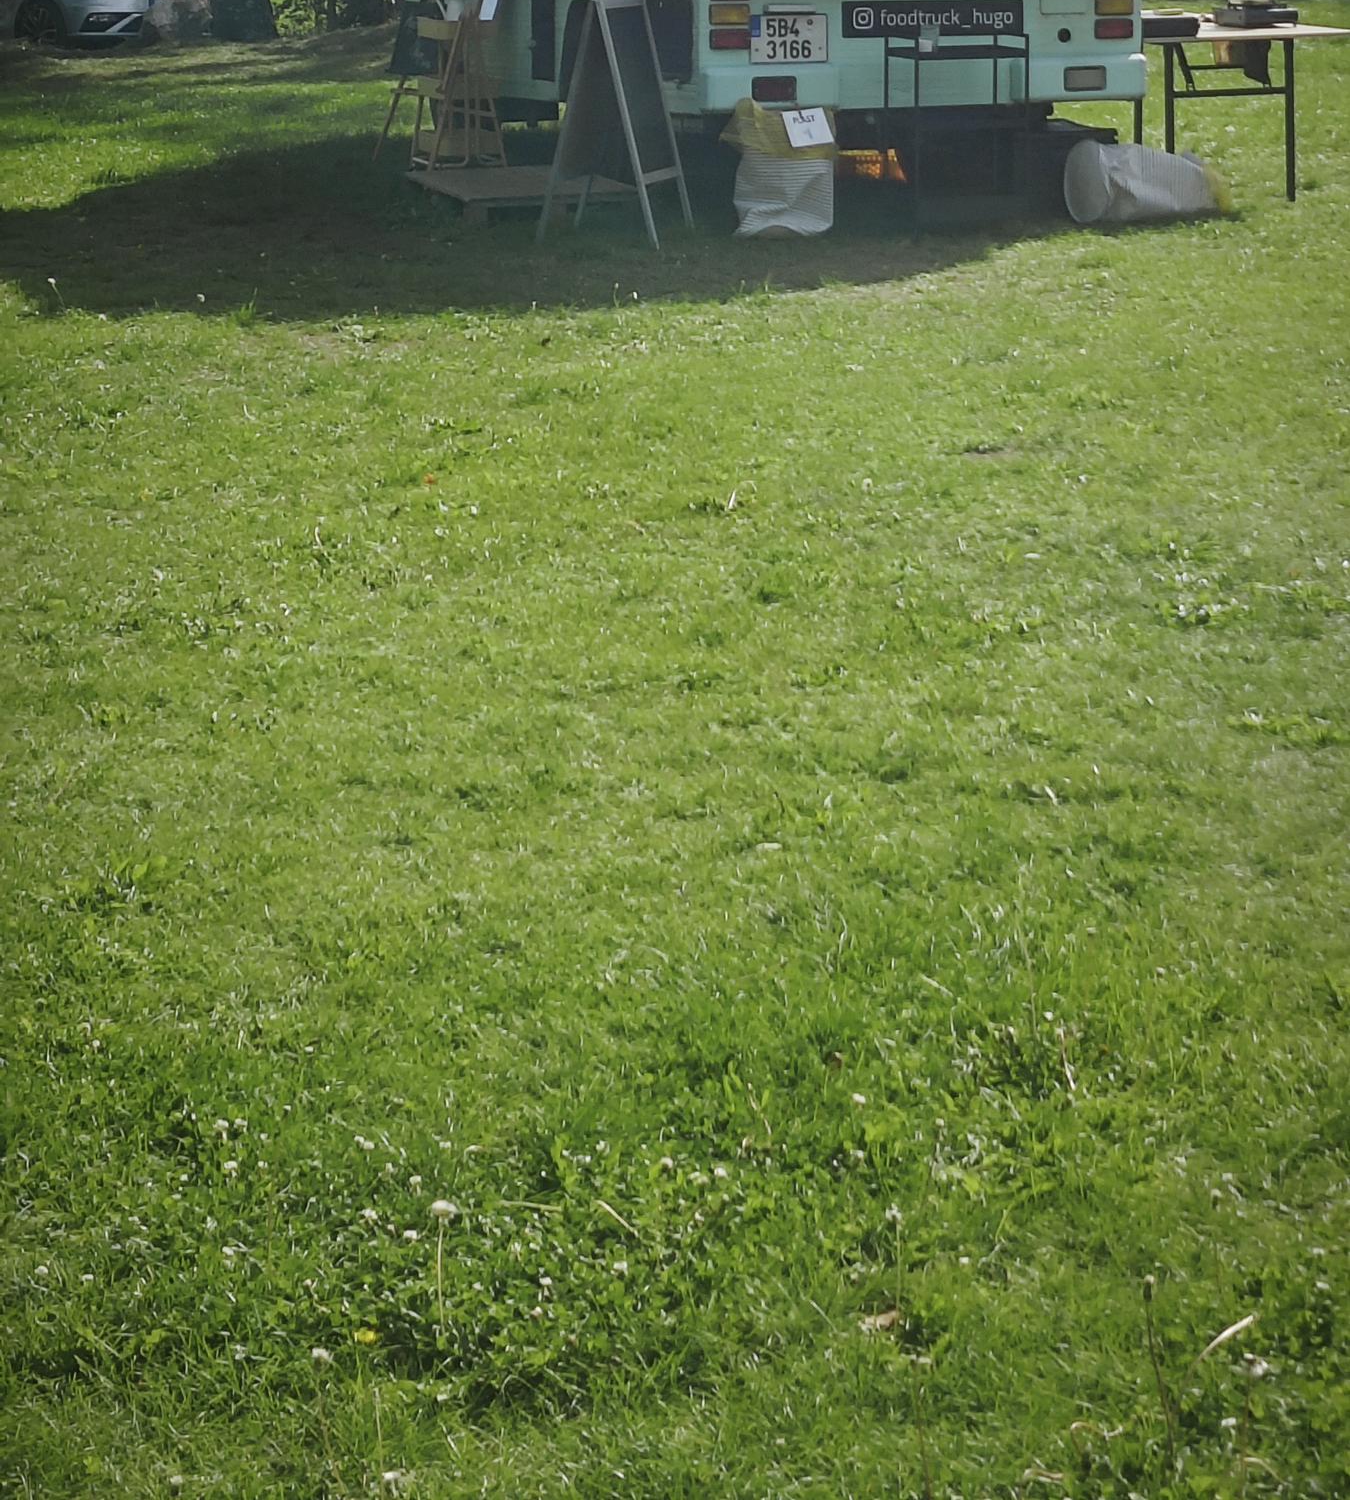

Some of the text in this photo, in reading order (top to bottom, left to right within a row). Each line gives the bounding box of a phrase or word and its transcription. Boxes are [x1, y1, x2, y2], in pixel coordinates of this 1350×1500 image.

[766, 18, 800, 38] 5B4
[880, 8, 1014, 29] foodtruck_hugo
[766, 40, 812, 59] 3166
